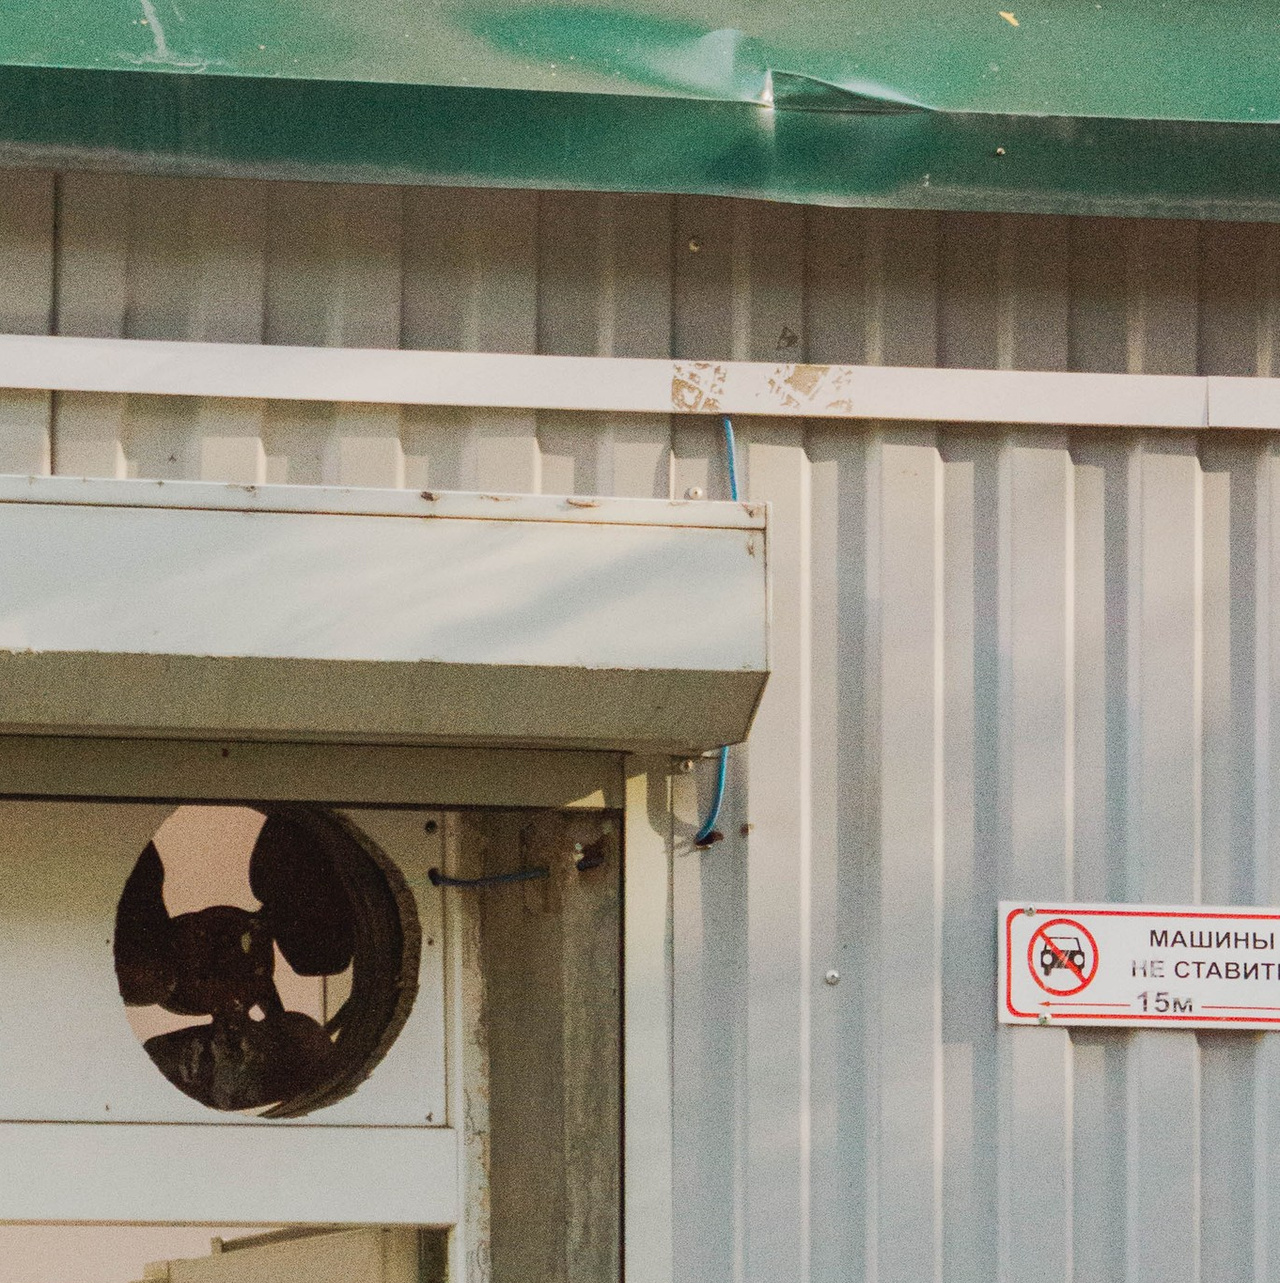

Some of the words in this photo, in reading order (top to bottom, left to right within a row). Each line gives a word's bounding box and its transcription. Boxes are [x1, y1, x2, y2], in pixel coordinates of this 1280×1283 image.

[1149, 929, 1274, 949] МАШИНЫ
[1131, 959, 1165, 978] НЕ
[1174, 959, 1280, 980] СТАВИТ
